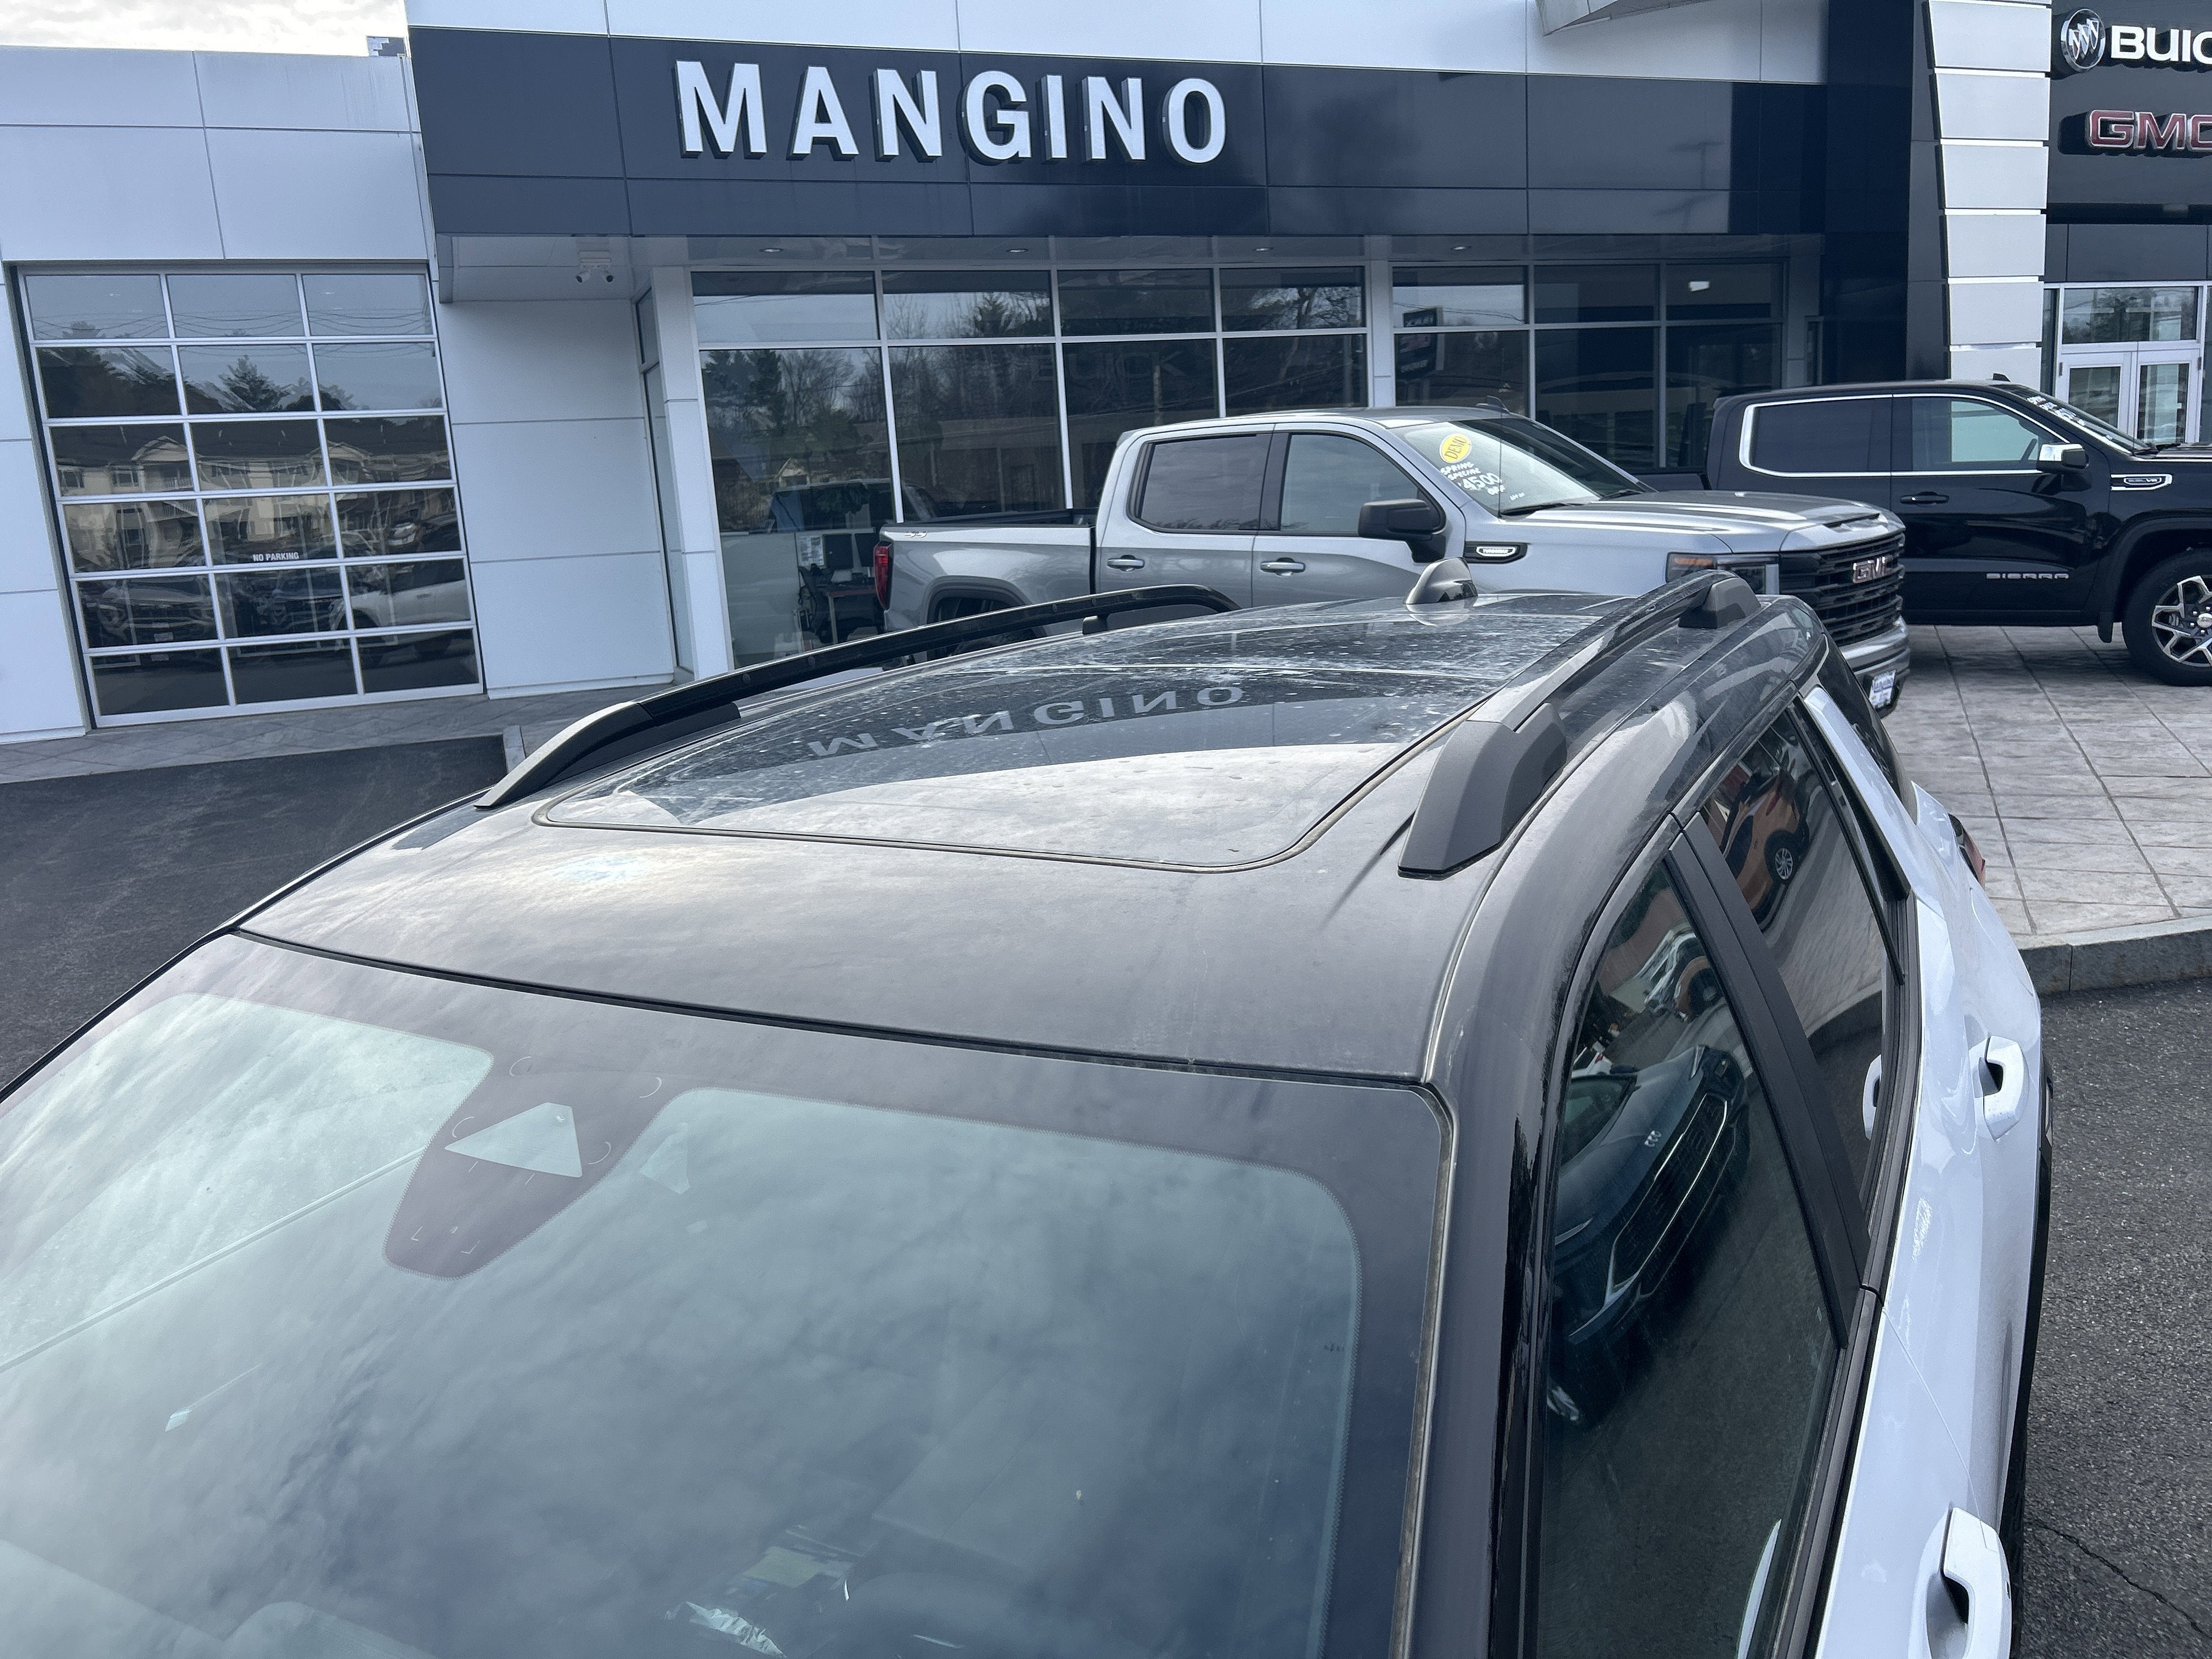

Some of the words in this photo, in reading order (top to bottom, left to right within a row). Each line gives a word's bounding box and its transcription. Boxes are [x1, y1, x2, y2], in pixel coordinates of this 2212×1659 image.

[674, 60, 1227, 164] MANGINO
[1444, 436, 1466, 460] DEMO
[1440, 461, 1474, 475] SPRING
[1447, 467, 1481, 481] SPECIAL
[253, 554, 264, 562] NO
[265, 551, 300, 561] PARKING
